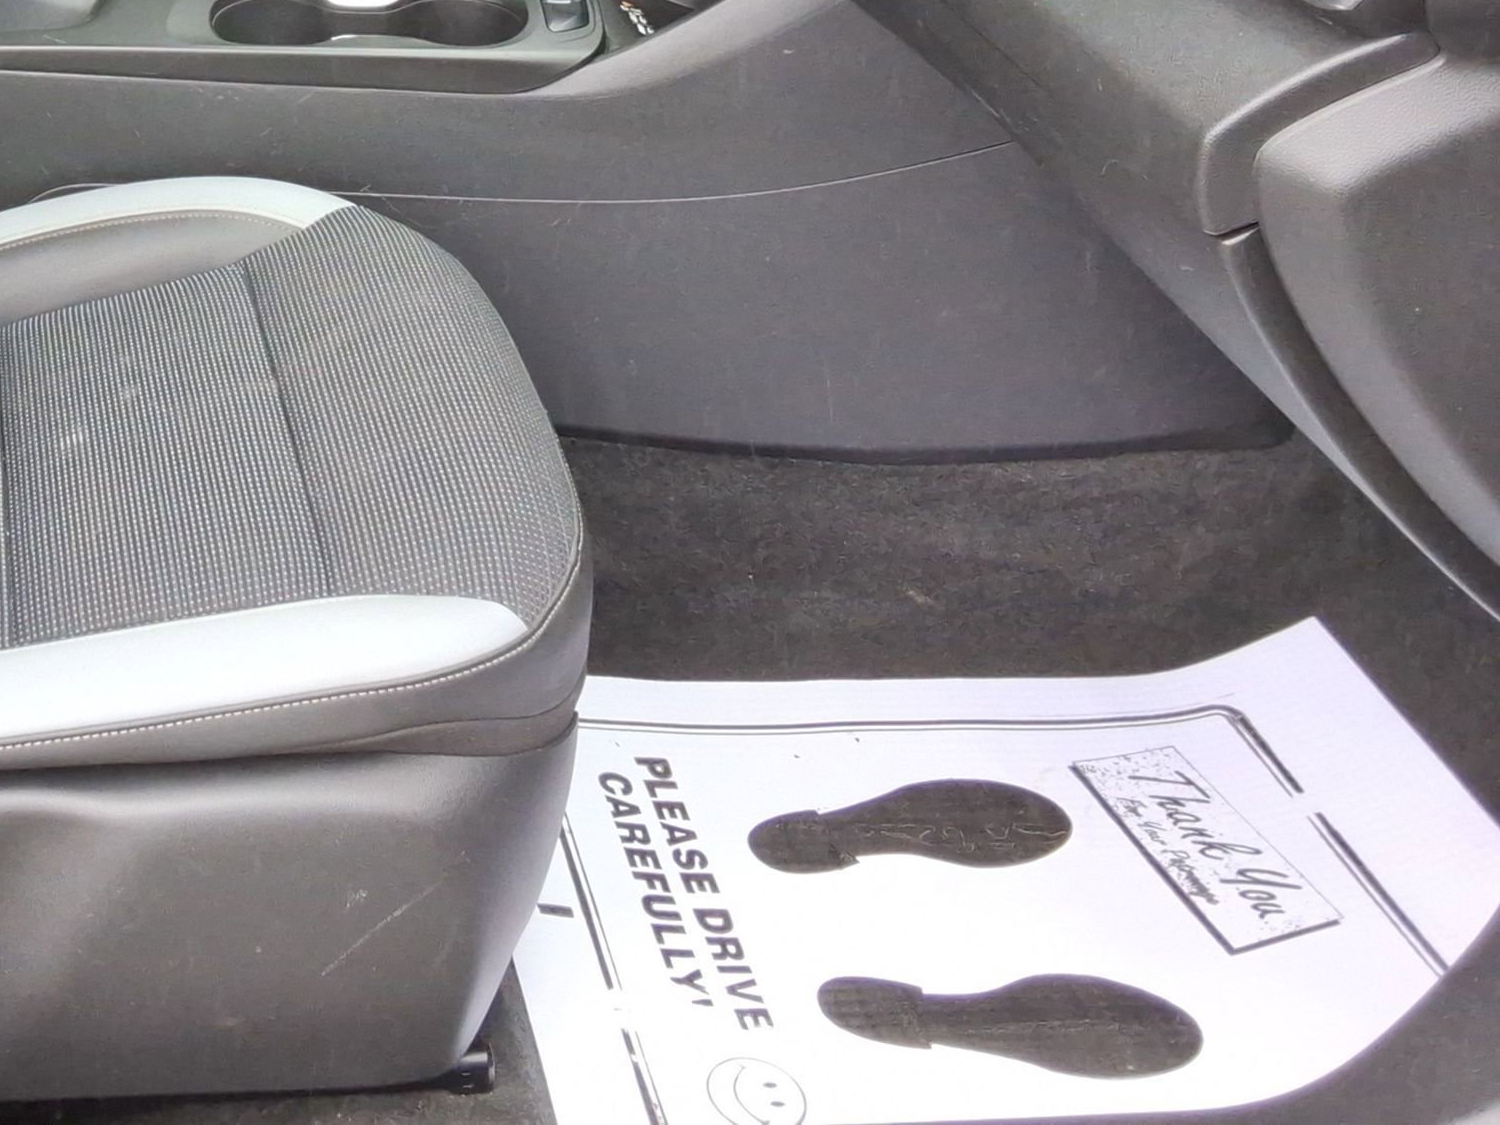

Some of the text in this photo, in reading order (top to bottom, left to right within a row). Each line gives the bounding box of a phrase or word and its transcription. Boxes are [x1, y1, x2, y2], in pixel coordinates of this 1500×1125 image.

[633, 756, 774, 1030] PLEASE DRIVE
[1128, 770, 1303, 919] Thank You
[1137, 820, 1168, 846] Your
